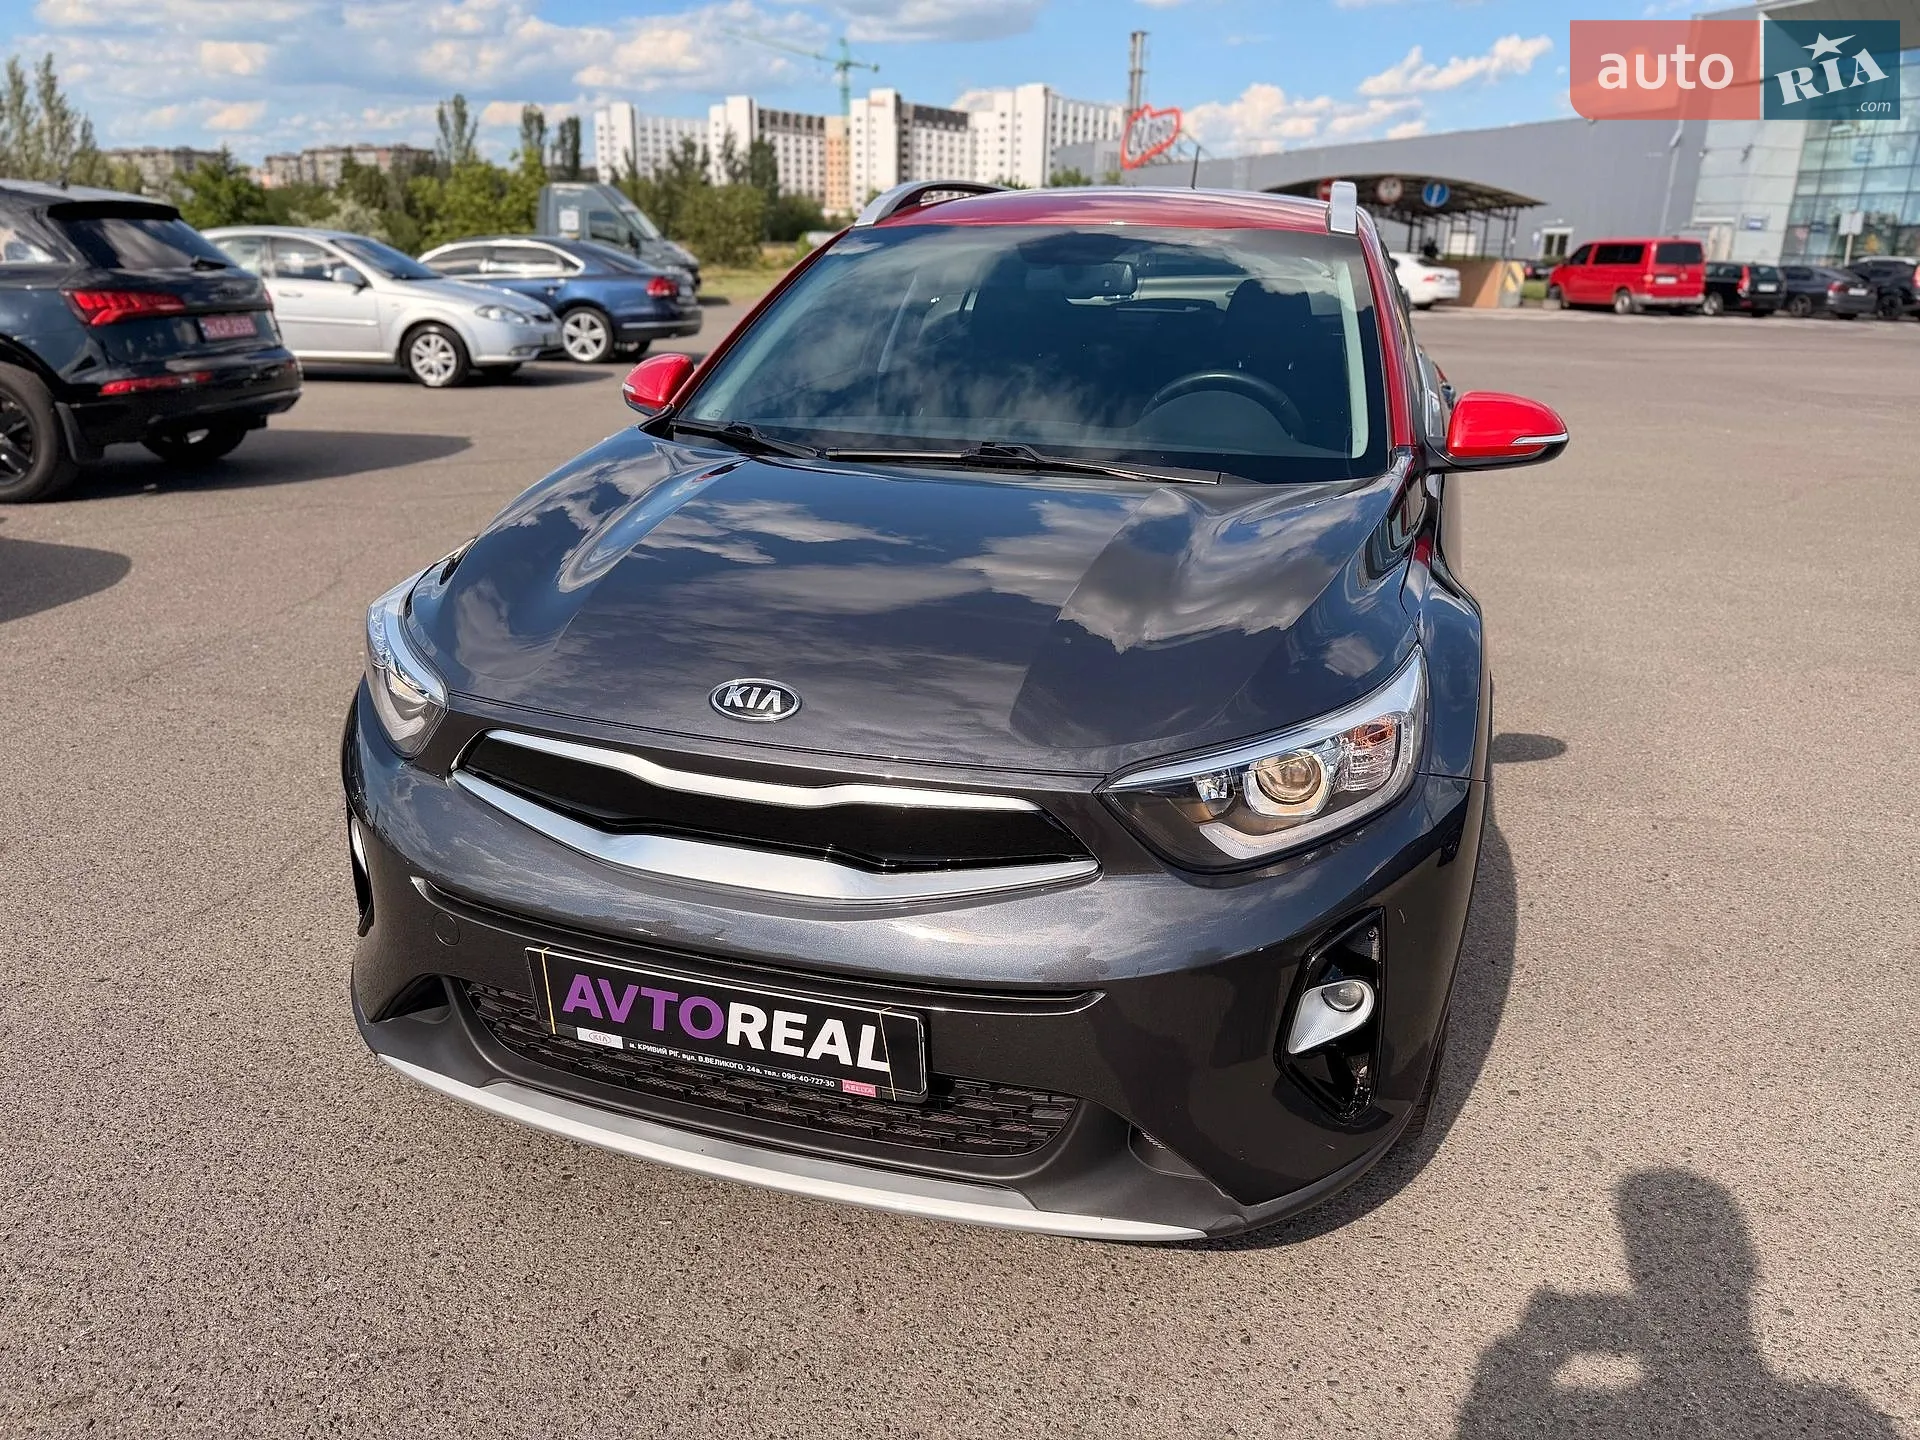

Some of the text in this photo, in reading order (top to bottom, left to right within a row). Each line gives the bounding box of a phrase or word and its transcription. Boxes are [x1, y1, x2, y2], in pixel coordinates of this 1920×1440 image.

[723, 685, 782, 713] KIA
[562, 973, 892, 1074] AVTOREAL
[637, 1043, 668, 1056] КРИВИЙ
[681, 1053, 697, 1061] вул.
[781, 1071, 835, 1088] 096-40-727-30
